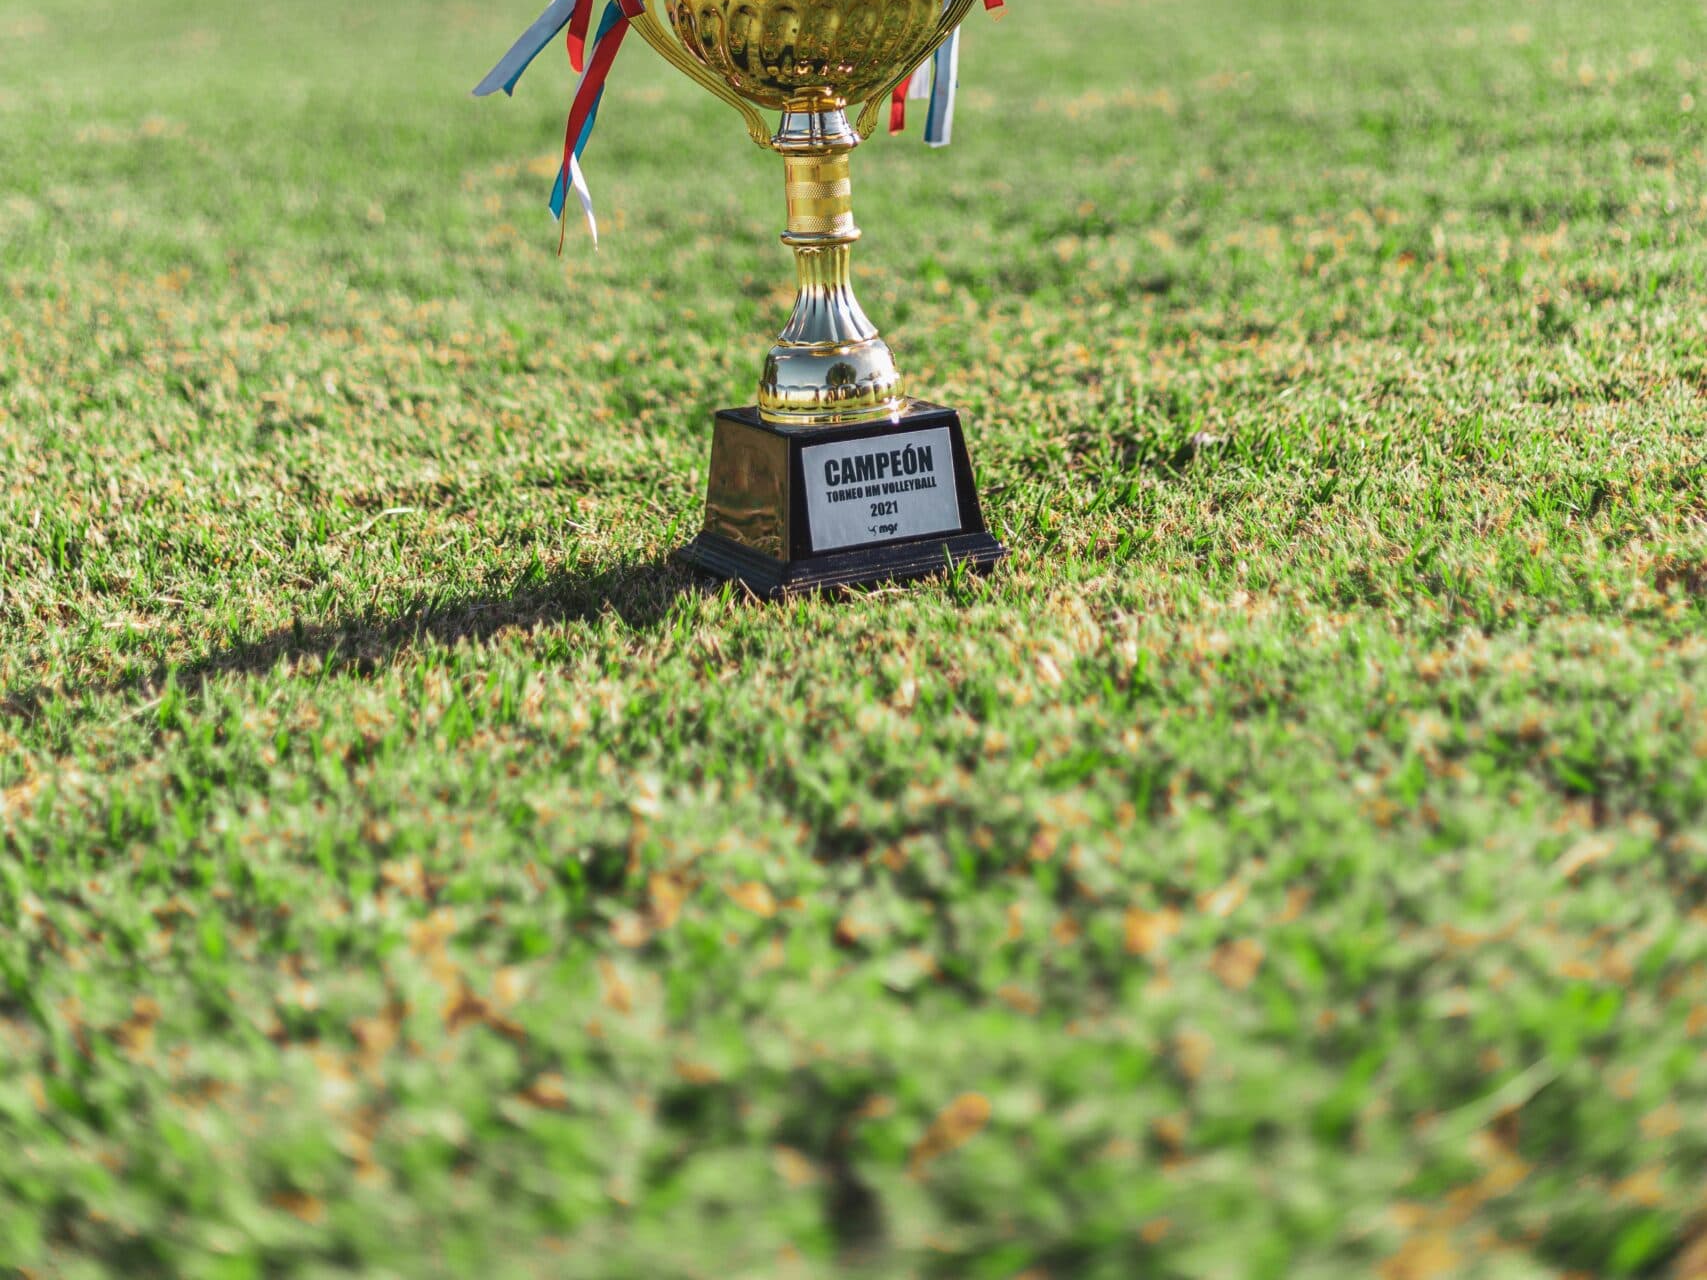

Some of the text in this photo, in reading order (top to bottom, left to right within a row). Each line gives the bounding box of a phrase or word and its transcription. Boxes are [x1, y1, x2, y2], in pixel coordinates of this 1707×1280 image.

[824, 443, 934, 487] CAMPEÓN
[826, 487, 864, 503] TORNEO
[882, 476, 937, 494] VOLLEYBALL
[870, 500, 899, 517] 2021
